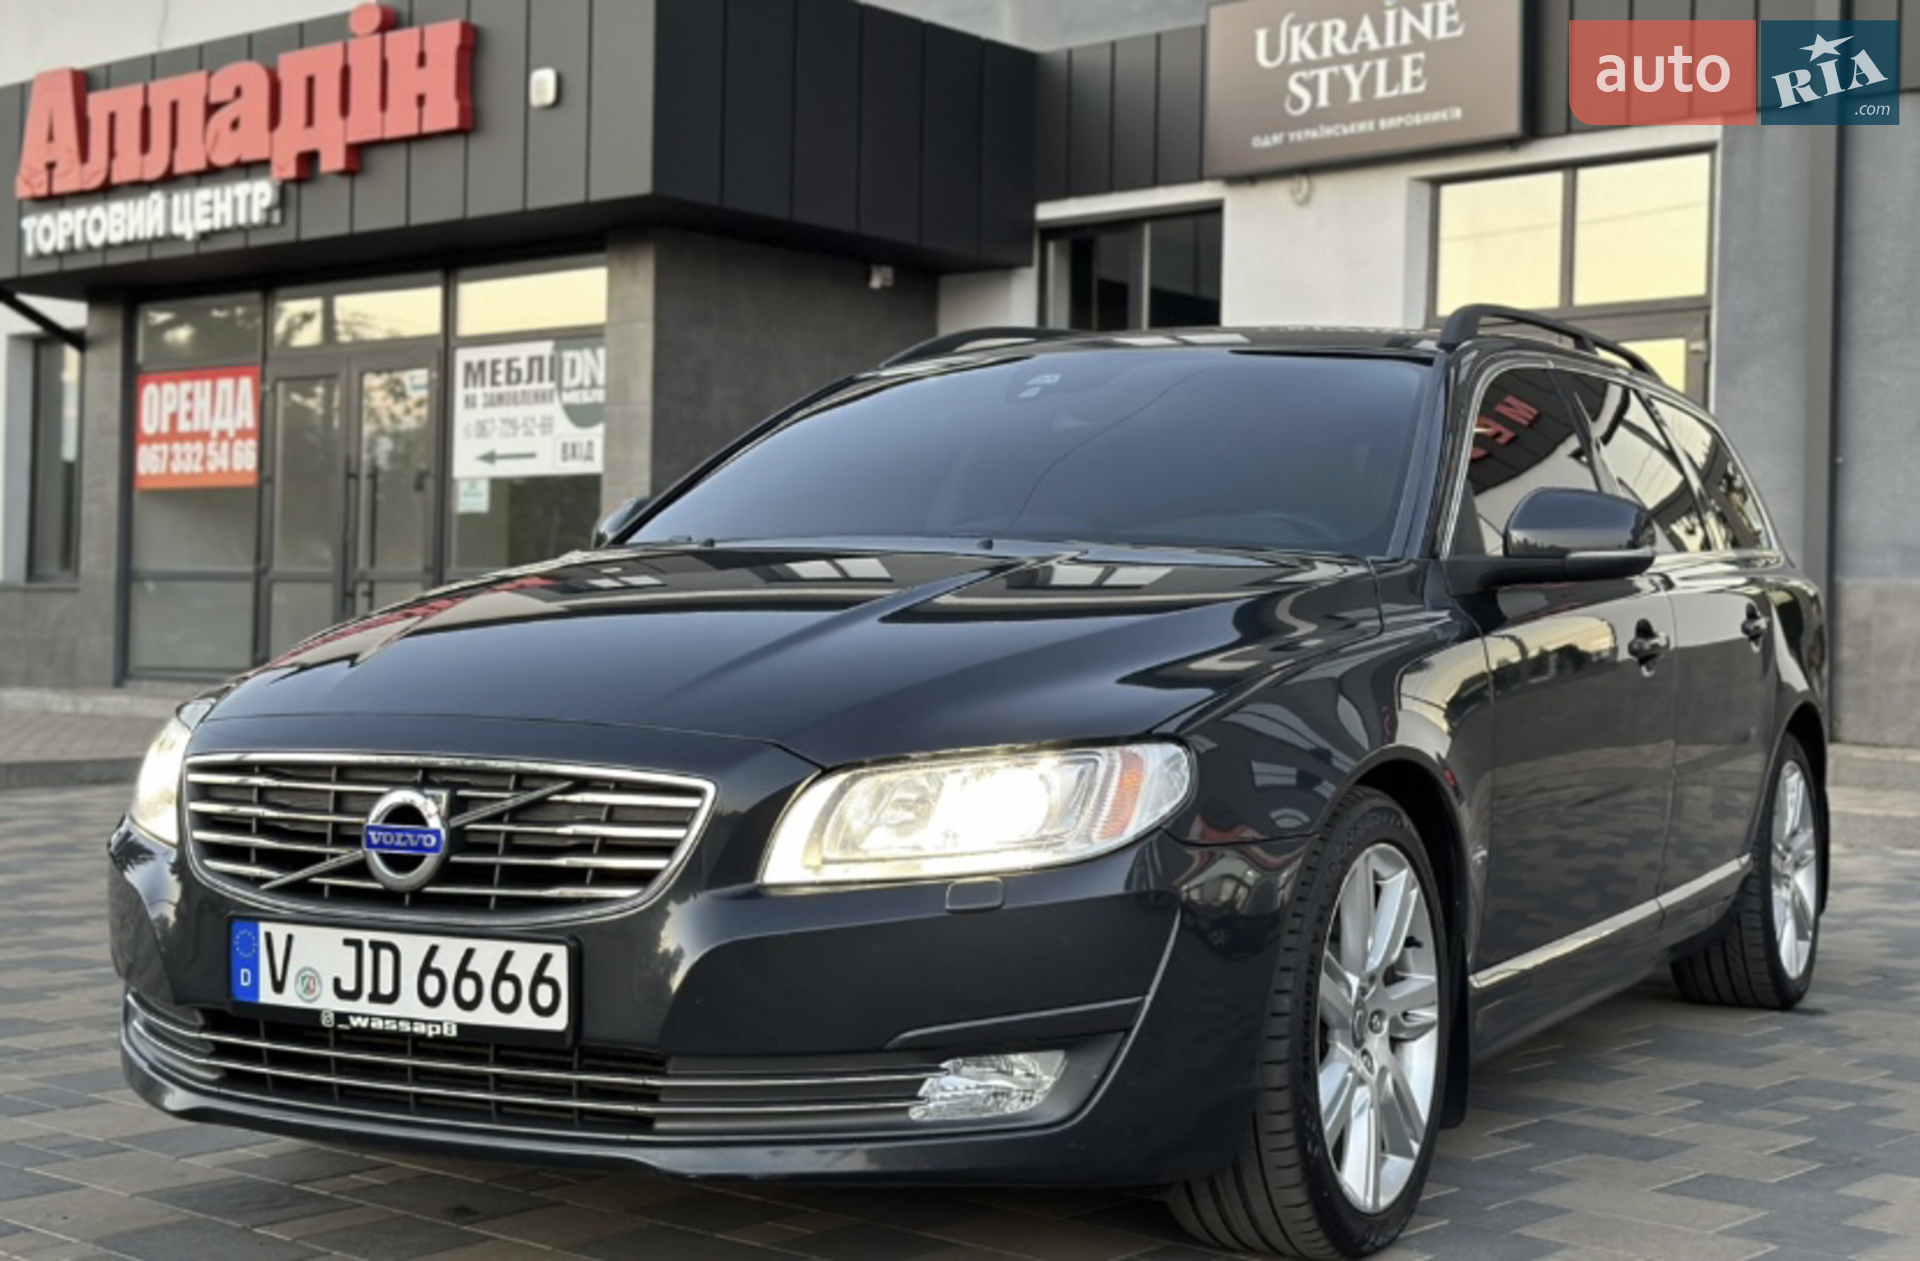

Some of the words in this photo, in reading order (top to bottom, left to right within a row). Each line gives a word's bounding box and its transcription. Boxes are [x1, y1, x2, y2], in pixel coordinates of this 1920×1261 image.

[15, 3, 475, 198] Алладін
[1284, 52, 1428, 116] STYLE
[20, 190, 166, 257] ТОРГОВИЙ
[463, 354, 557, 389] МЕБЛІ
[142, 375, 255, 440] ОРЕНДА
[368, 830, 437, 848] VOLVO
[240, 967, 251, 987] D
[264, 931, 294, 995] V
[333, 938, 400, 1005] JD
[417, 943, 562, 1018] 6666
